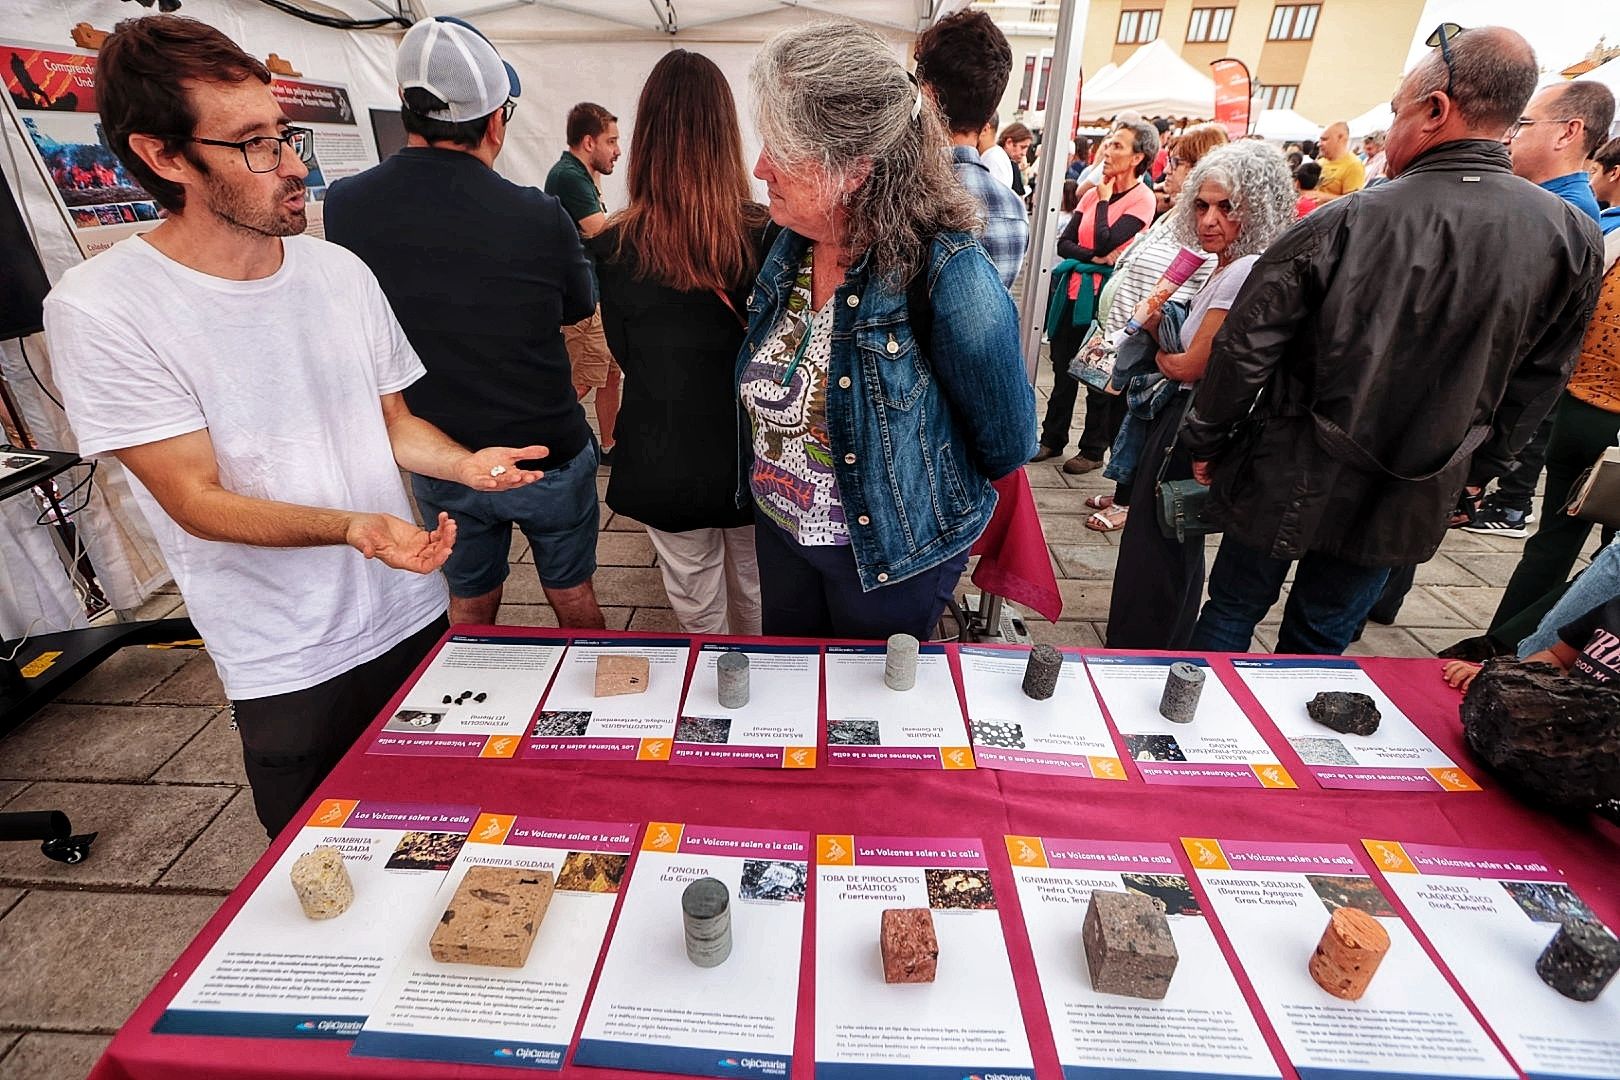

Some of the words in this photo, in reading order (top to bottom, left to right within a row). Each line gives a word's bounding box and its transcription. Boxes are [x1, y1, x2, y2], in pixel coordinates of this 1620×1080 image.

[44, 59, 95, 74] Comprend
[74, 76, 95, 88] Und
[1036, 758, 1070, 767] Volcanes
[1240, 770, 1251, 778] Los
[1377, 774, 1415, 782] Volcanes
[355, 811, 368, 819] Los
[372, 812, 406, 821] Volcanes
[532, 830, 566, 839] Volcanes
[568, 832, 589, 840] salen
[703, 838, 738, 847] Volcanes
[342, 853, 373, 861] enerife)
[860, 848, 874, 856] Los
[876, 849, 913, 857] Volcanes
[959, 850, 980, 858] calle
[1051, 850, 1066, 859] Los
[1068, 852, 1105, 861] Volcanes
[1108, 854, 1130, 862] salen
[1151, 855, 1172, 864] calle
[1247, 853, 1284, 862] Volcanes
[463, 856, 513, 866] IGNIMBRITA
[514, 860, 555, 868] SOLDADA
[1416, 856, 1432, 864] Los
[1434, 857, 1475, 868] Volcanes
[1478, 861, 1503, 870] salen
[1524, 864, 1547, 872] calle
[667, 867, 709, 875] FONOLITA
[846, 882, 897, 891] BASÁLTICOS
[1022, 876, 1072, 886] IGNIMBRITA
[1075, 879, 1117, 887] SOLDADA
[1207, 879, 1260, 887] IGNIMBRITA
[1261, 881, 1305, 889] SOLDADA
[1037, 886, 1065, 894] Piedra
[1427, 884, 1470, 893] BASALTO
[839, 893, 906, 902] (Fuerteventura)
[1042, 895, 1069, 903] (Arico,
[1235, 896, 1256, 904] Gran
[1259, 898, 1297, 907] Canaria)
[1417, 891, 1493, 904] PLAGIOCLÁSICO
[1456, 903, 1497, 913] Tenerife)
[516, 1049, 560, 1059] CajaCanarias
[741, 1058, 786, 1069] CajaCanarias
